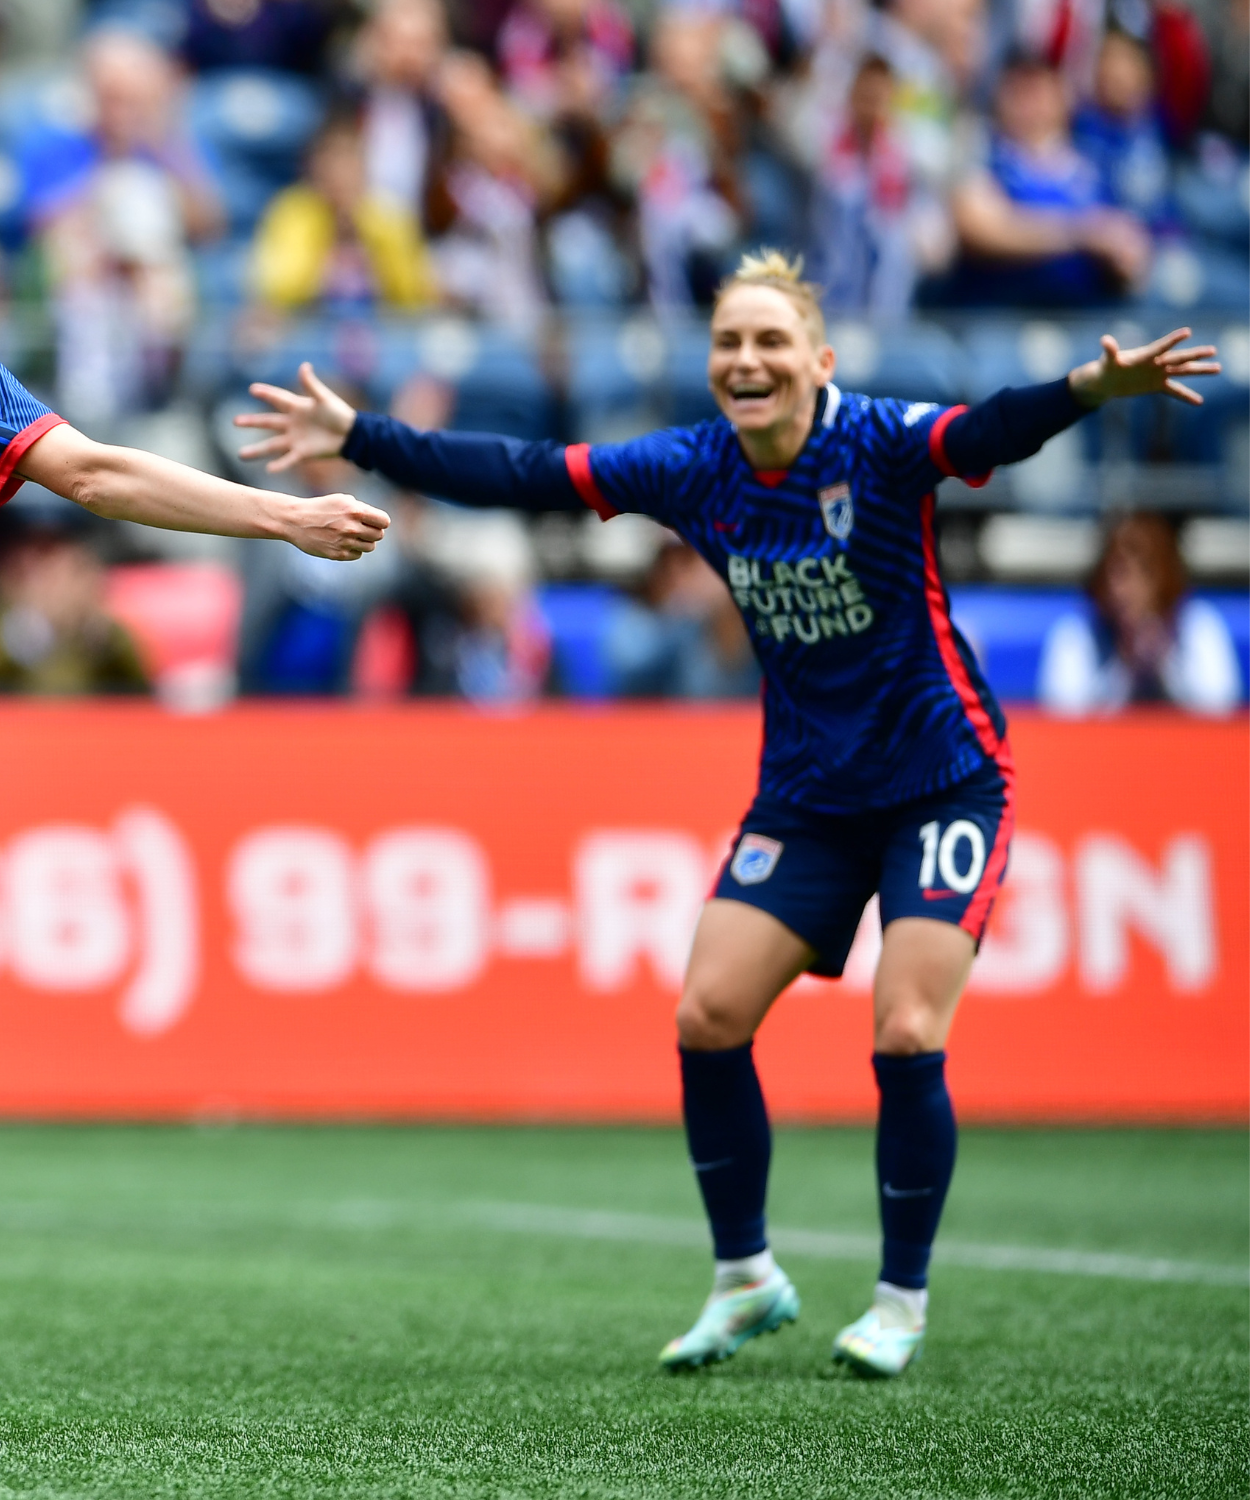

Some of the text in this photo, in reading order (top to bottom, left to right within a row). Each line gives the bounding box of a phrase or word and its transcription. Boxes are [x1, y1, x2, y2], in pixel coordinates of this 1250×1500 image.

[727, 553, 854, 588] BLACK
[732, 578, 866, 615] FUTURE
[769, 602, 875, 645] FUND
[918, 818, 986, 894] 10
